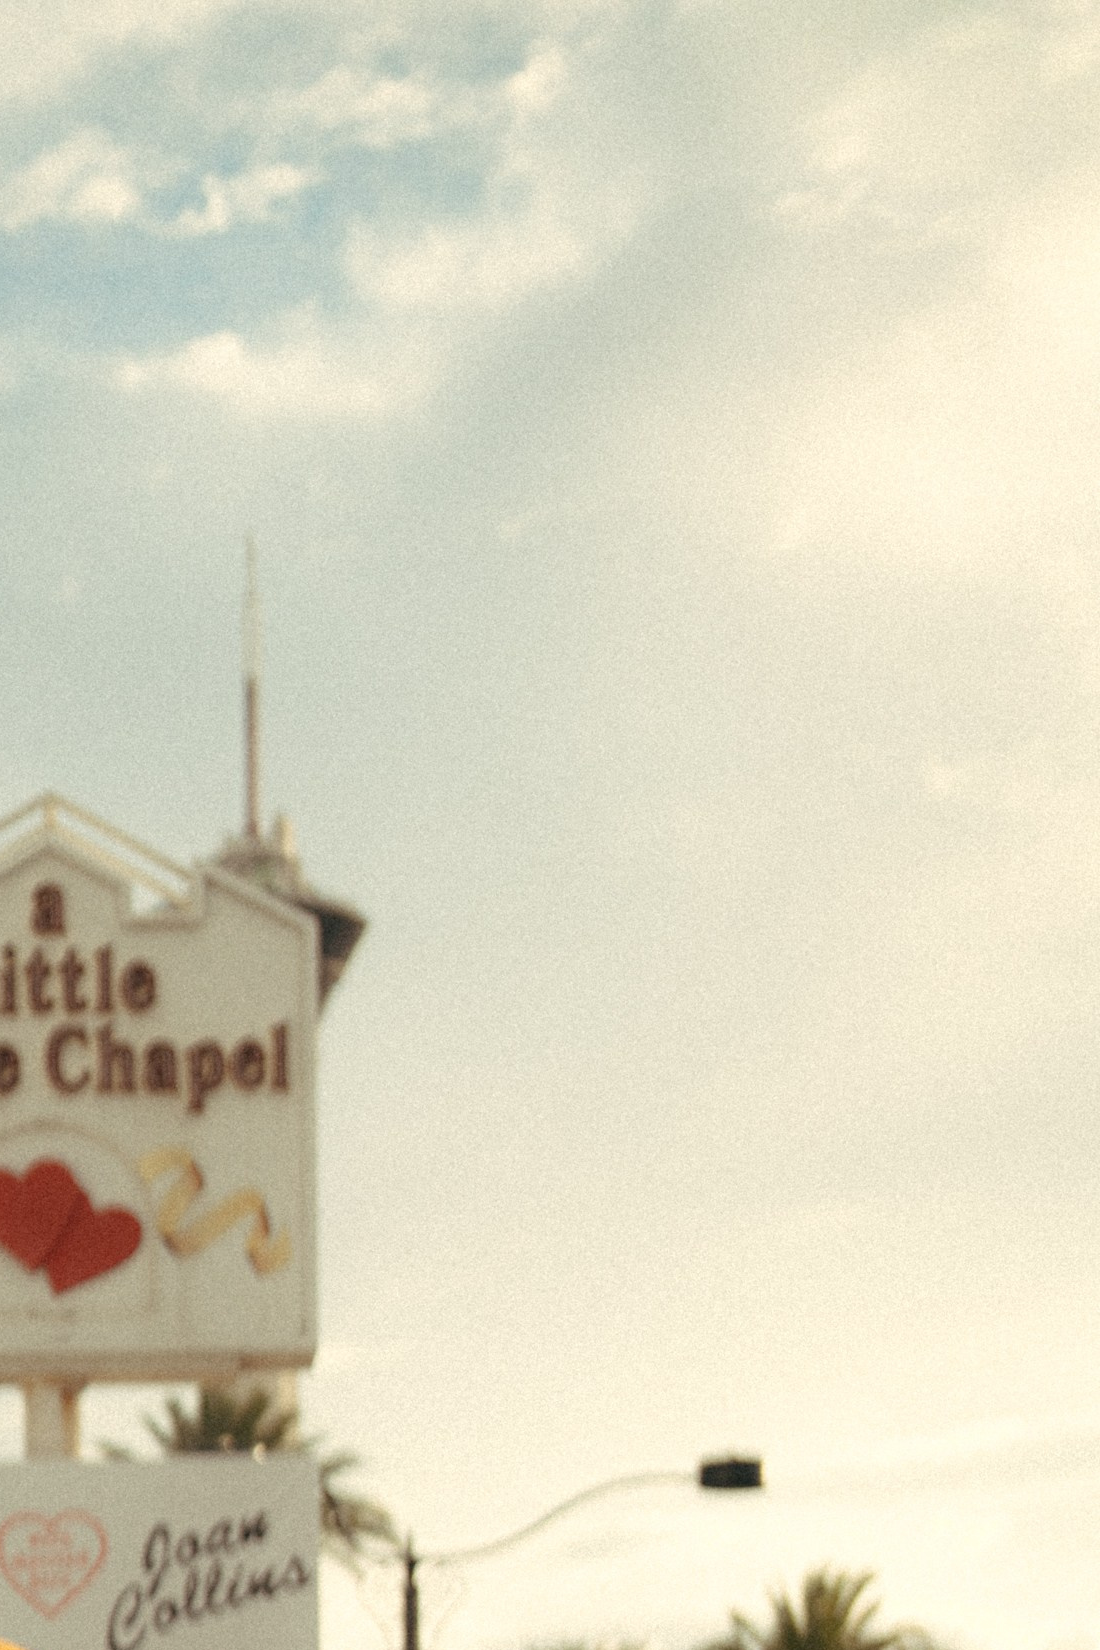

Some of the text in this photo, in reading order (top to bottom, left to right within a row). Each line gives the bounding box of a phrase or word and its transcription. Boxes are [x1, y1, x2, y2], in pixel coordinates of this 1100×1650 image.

[31, 882, 65, 935] a
[46, 1022, 290, 1116] Chapel
[143, 1508, 270, 1597] Joan
